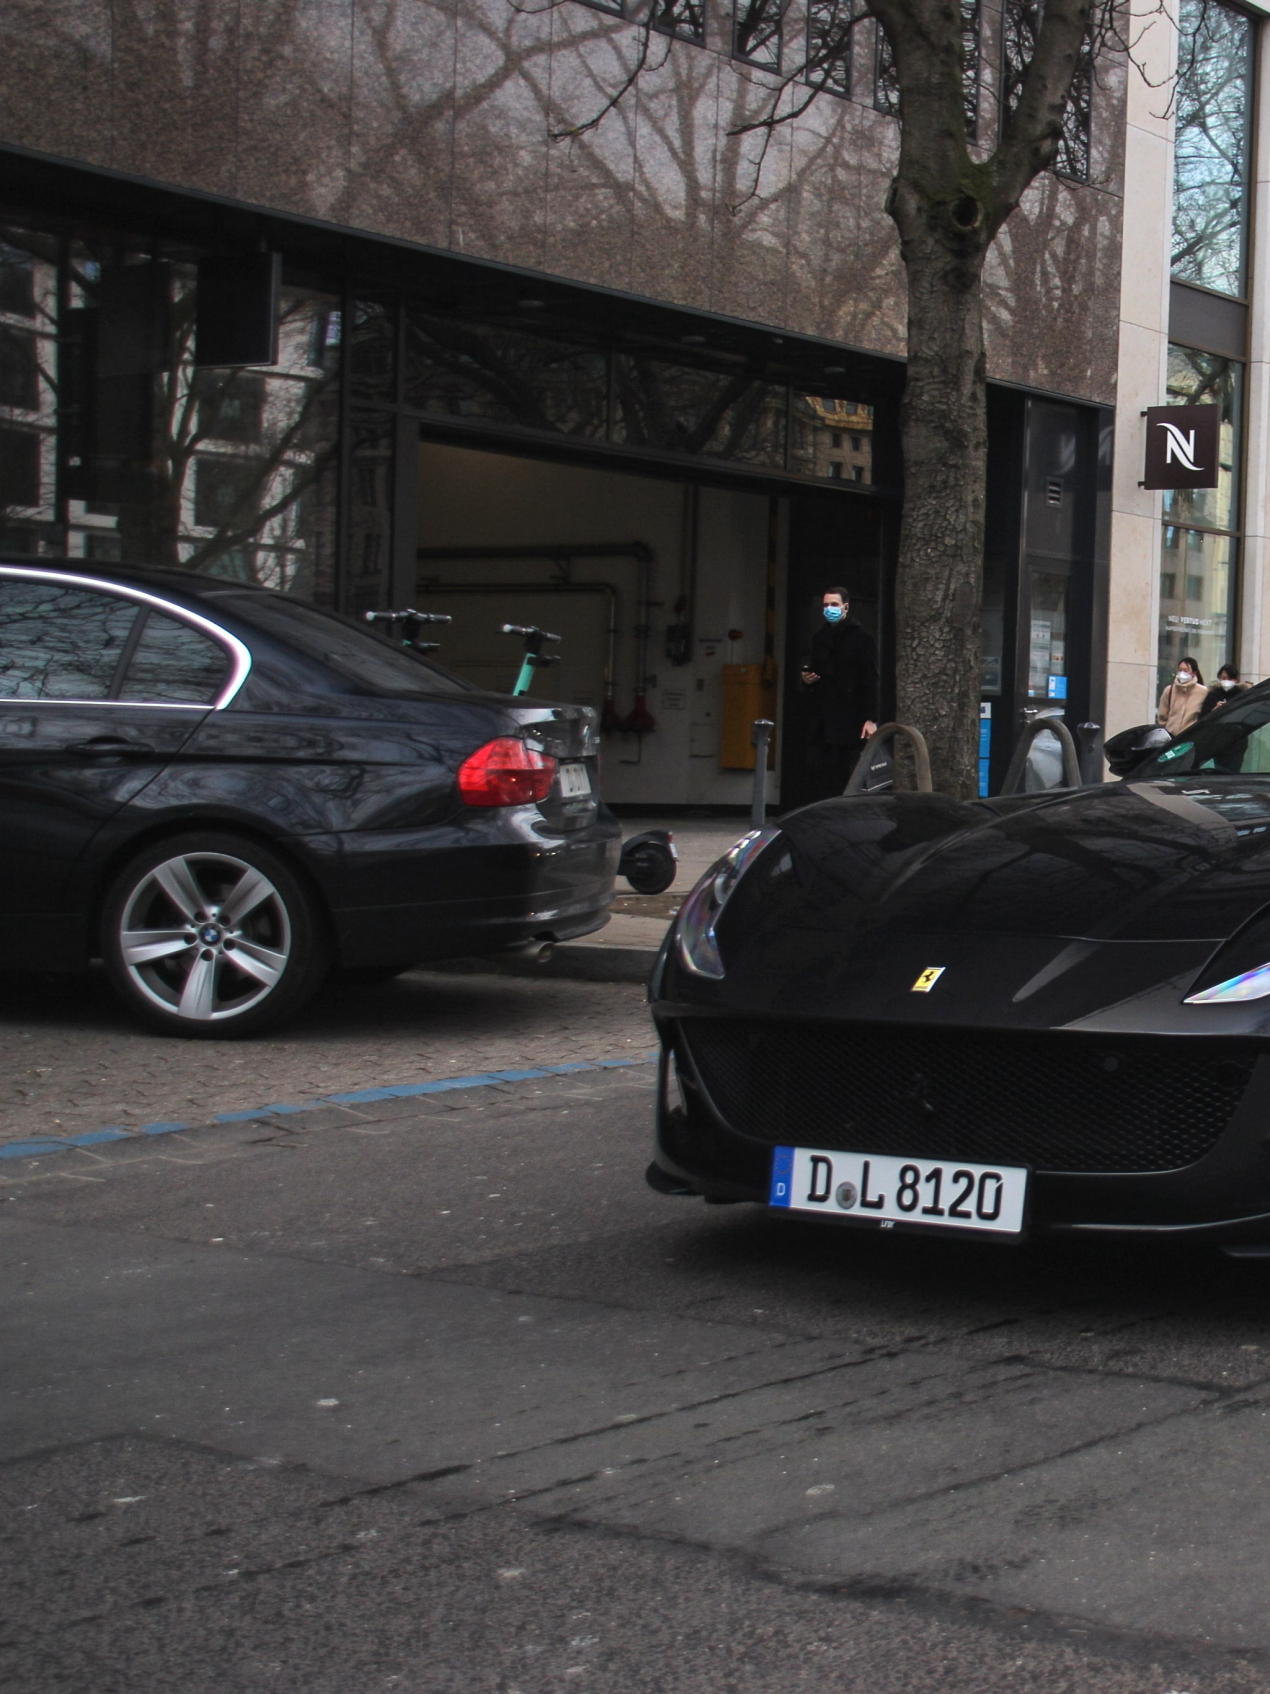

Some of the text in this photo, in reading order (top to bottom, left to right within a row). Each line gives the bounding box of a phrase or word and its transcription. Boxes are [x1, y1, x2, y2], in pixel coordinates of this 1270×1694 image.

[776, 1182, 786, 1197] D
[807, 1154, 1004, 1221] D L 8120
